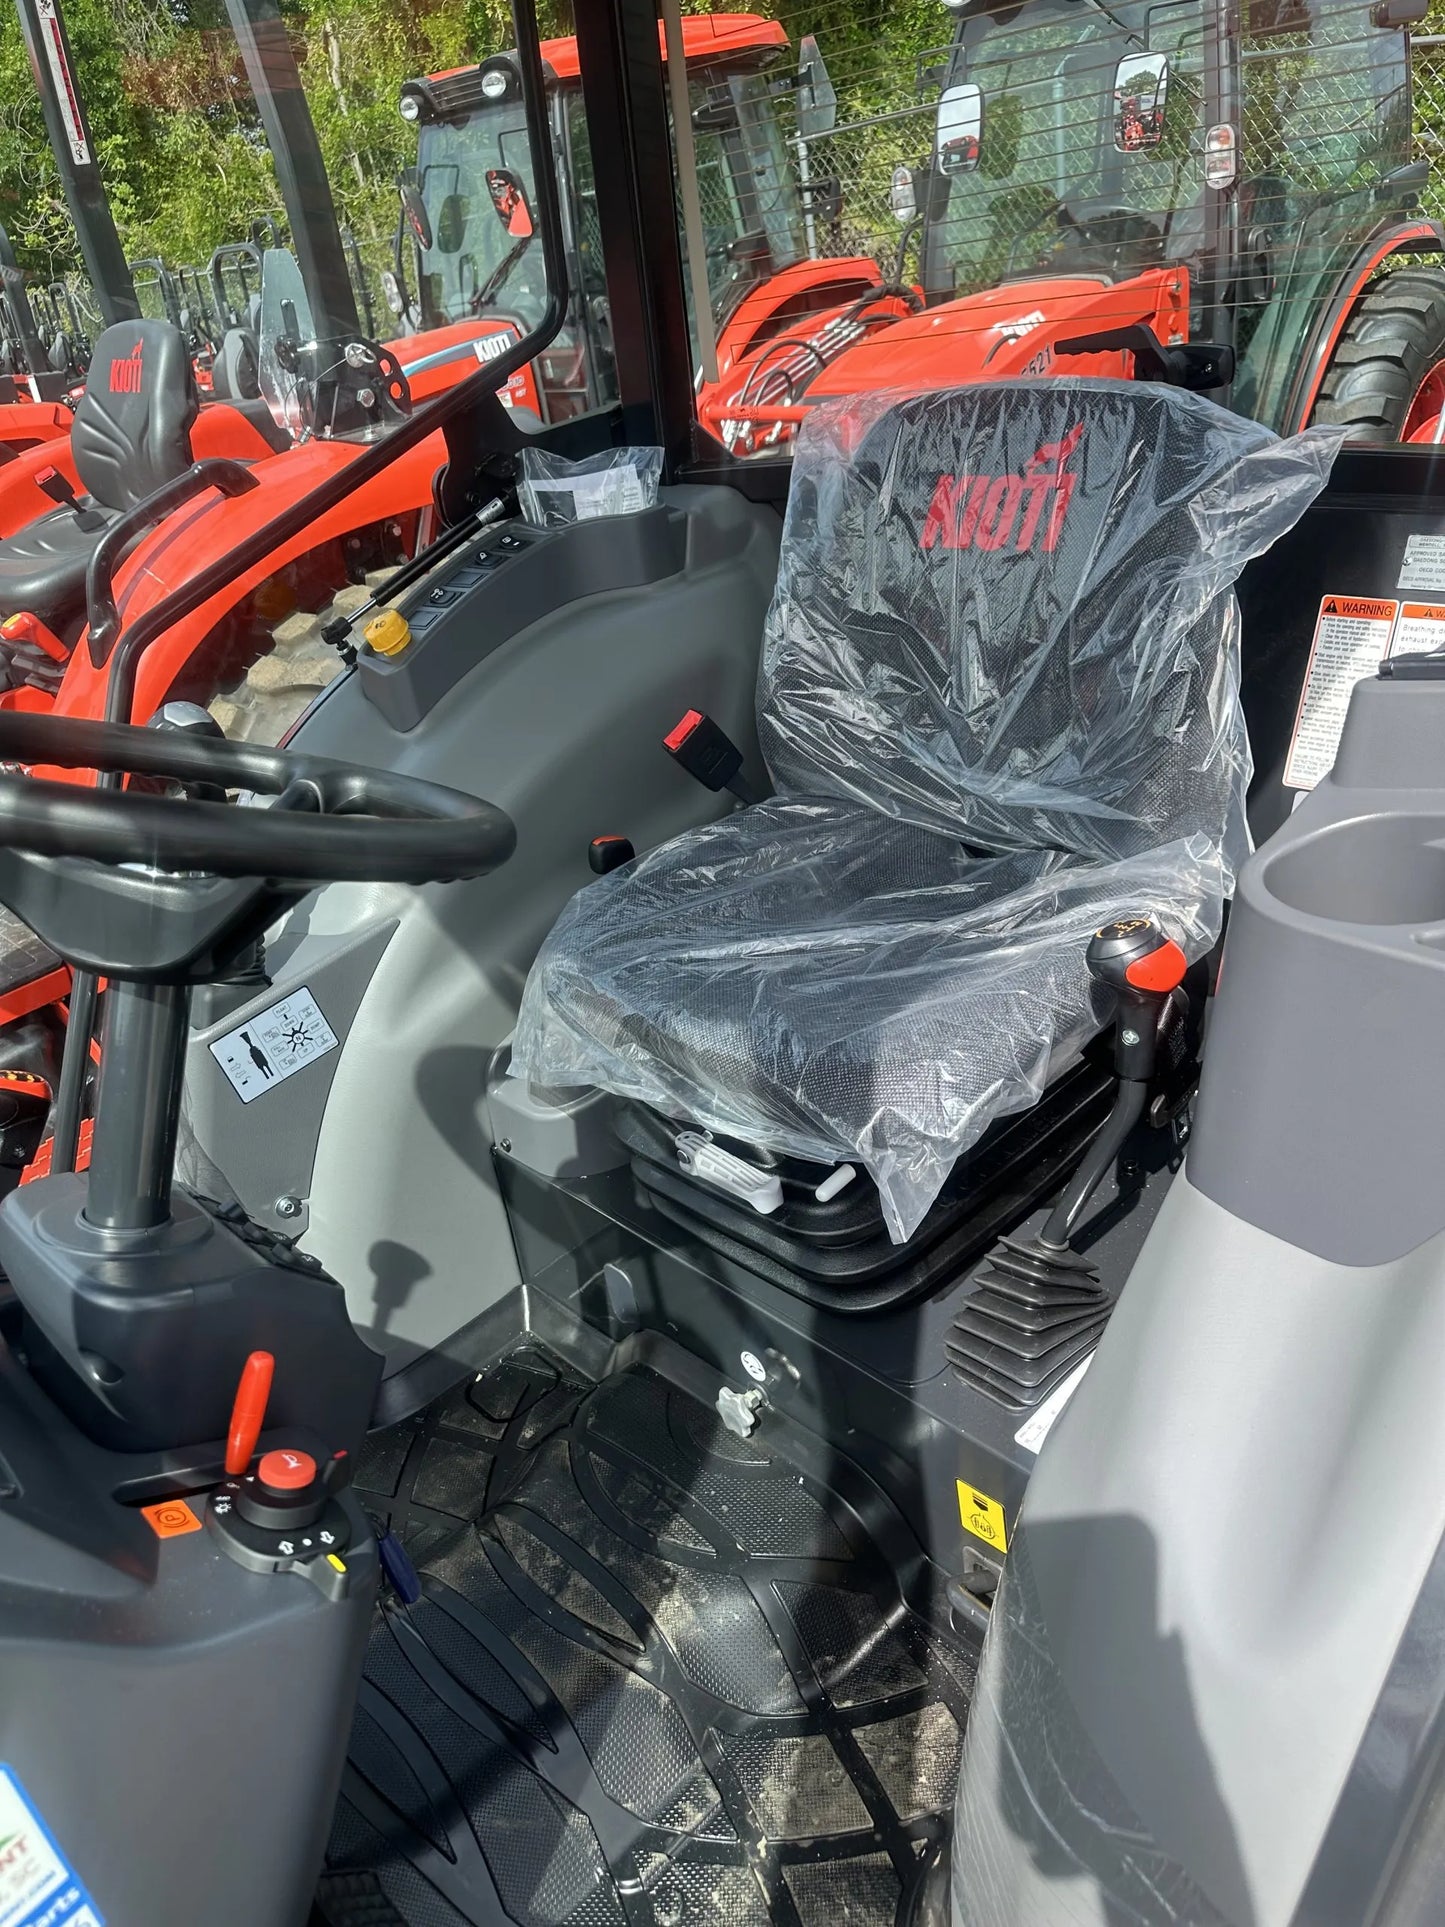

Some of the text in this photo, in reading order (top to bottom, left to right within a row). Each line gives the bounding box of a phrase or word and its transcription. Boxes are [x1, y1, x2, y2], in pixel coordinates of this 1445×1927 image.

[473, 333, 512, 364] KIOTI
[919, 473, 1078, 553] KIOTI
[1342, 602, 1393, 617] WARNING
[1403, 624, 1436, 635] Breathing
